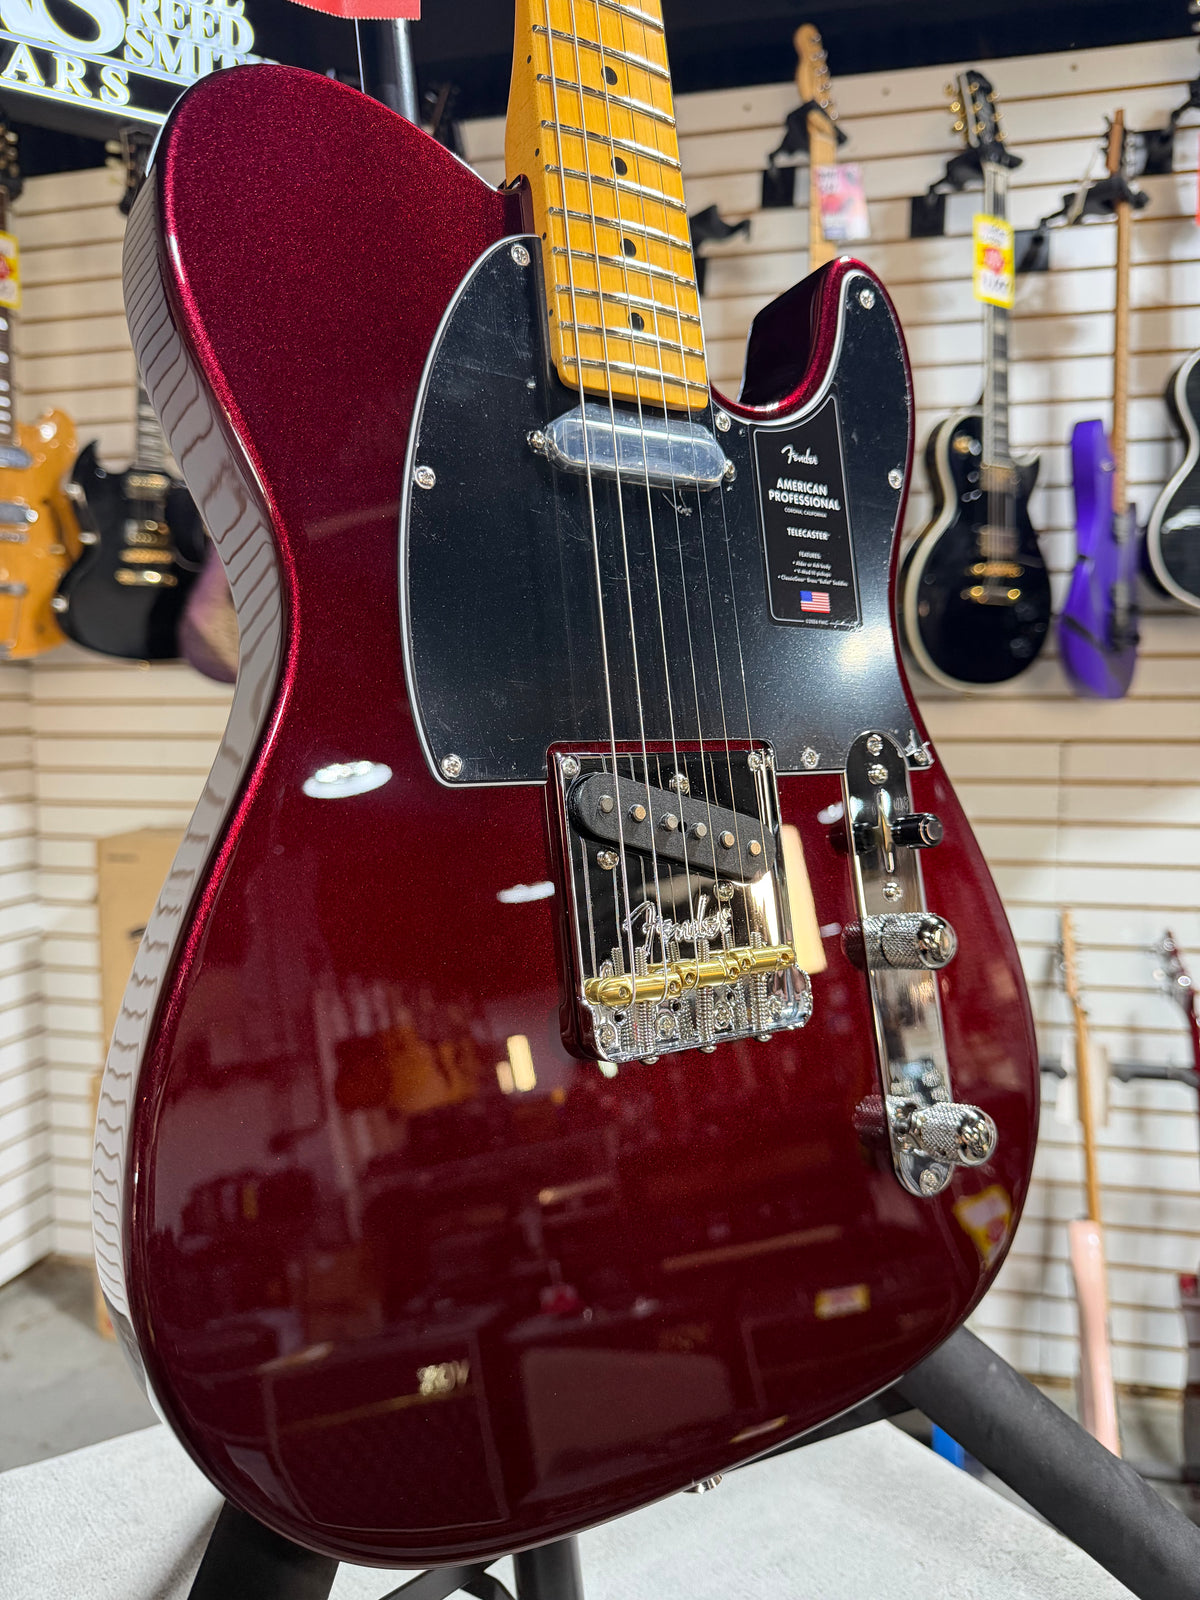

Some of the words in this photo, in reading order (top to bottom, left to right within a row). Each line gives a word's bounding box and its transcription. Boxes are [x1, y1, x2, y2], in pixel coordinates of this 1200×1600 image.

[127, 0, 254, 54] REED
[124, 24, 279, 79] SMIT
[1, 43, 130, 106] ARS
[781, 444, 819, 465] Fender
[768, 488, 841, 511] PROFESSIONAL
[776, 477, 828, 497] AMERICAN
[787, 526, 829, 541] TELECASTER
[622, 893, 733, 955] Fender
